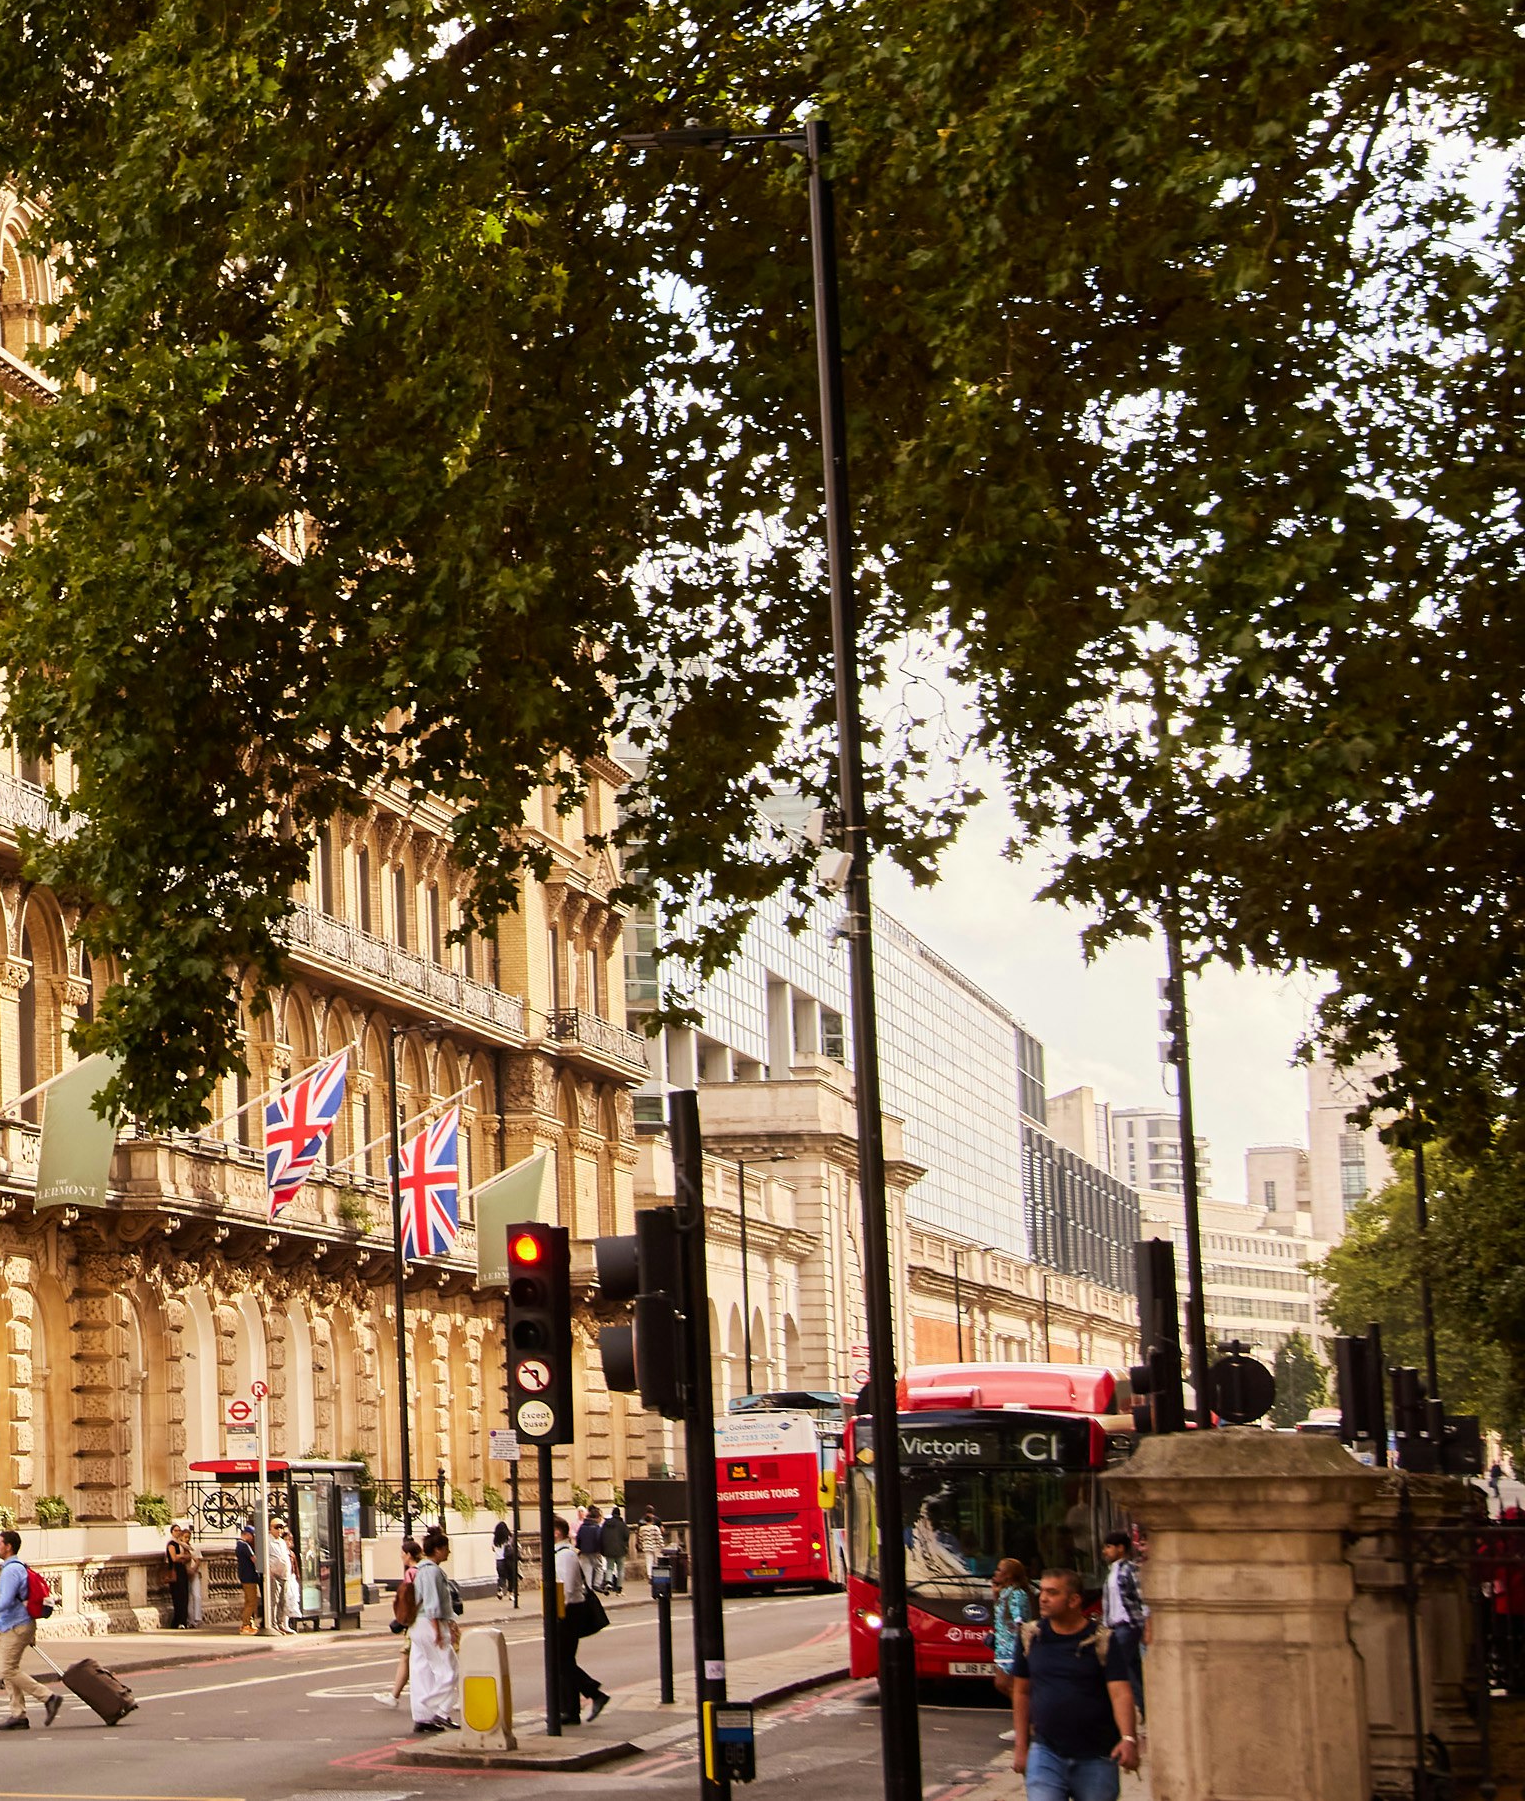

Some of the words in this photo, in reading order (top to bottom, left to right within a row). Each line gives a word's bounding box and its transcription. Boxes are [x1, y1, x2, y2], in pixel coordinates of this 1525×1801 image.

[254, 1383, 264, 1395] R
[521, 1411, 550, 1419] Except
[901, 1436, 981, 1455] Victoria
[717, 1489, 770, 1502] SIGHTSEEING
[770, 1487, 800, 1499] TOURS
